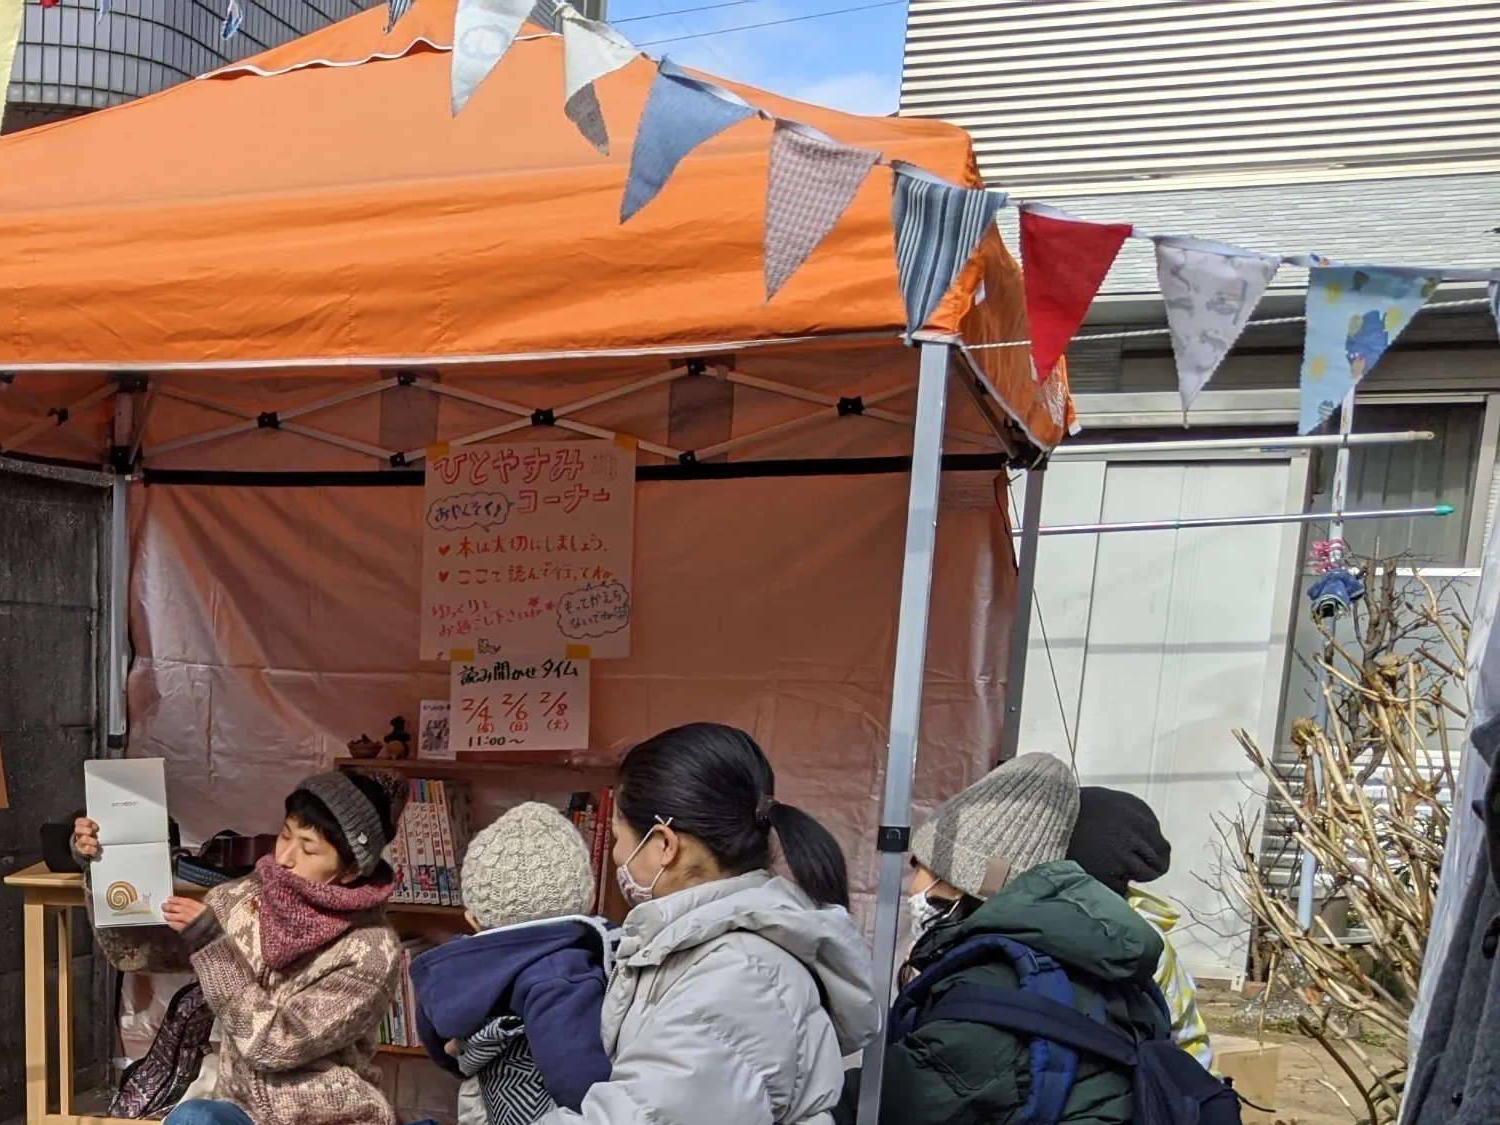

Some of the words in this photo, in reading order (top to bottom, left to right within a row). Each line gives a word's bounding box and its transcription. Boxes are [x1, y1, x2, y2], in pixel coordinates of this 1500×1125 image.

[433, 447, 585, 485] ひとやすみ
[517, 483, 611, 515] コーナー
[461, 697, 494, 724] 2/4
[502, 693, 528, 720] 2/6
[539, 692, 568, 717] 2/8
